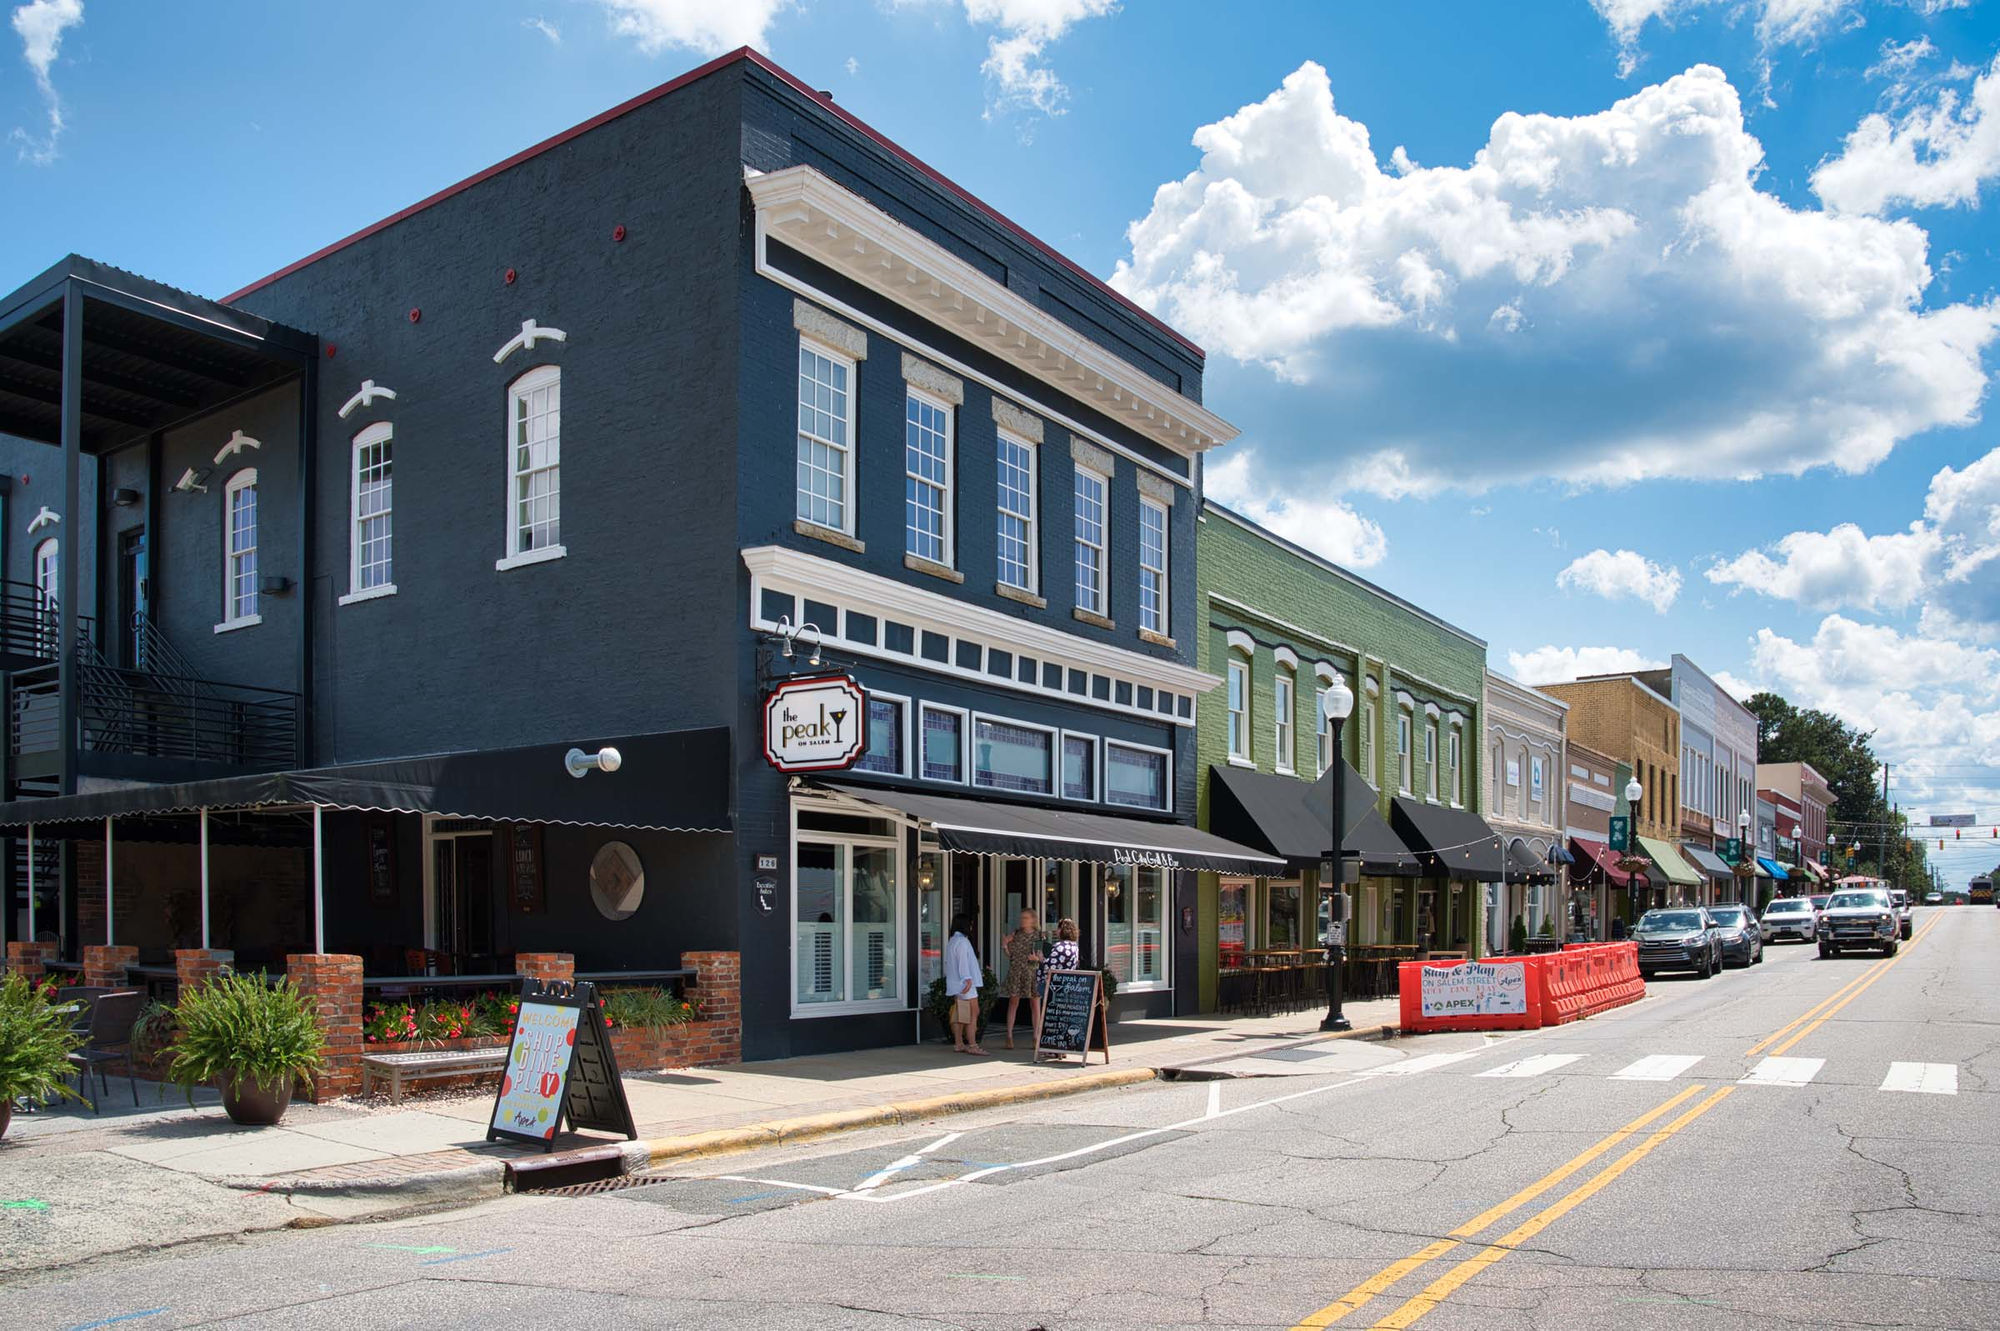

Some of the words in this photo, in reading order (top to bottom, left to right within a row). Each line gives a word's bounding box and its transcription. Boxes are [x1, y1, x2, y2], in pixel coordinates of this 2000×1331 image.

[783, 707, 798, 722] the
[782, 703, 831, 748] peak
[809, 739, 831, 747] SALEM
[1115, 849, 1131, 863] Peak
[1131, 850, 1147, 865] City
[1146, 851, 1161, 865] Grill
[1161, 853, 1167, 867] &
[1167, 853, 1179, 867] Bar
[1424, 968, 1449, 979] Stay
[1452, 967, 1462, 976] &
[1466, 964, 1495, 977] Play
[1423, 979, 1435, 987] ON
[1437, 977, 1465, 986] SALEM
[1466, 976, 1497, 985] STREET
[1499, 975, 1522, 986] Apex
[1445, 999, 1475, 1009] APEX
[523, 1014, 575, 1028] WELCOME
[525, 1032, 563, 1053] SHOP
[520, 1050, 558, 1074] DINE
[515, 1072, 555, 1096] PLAY
